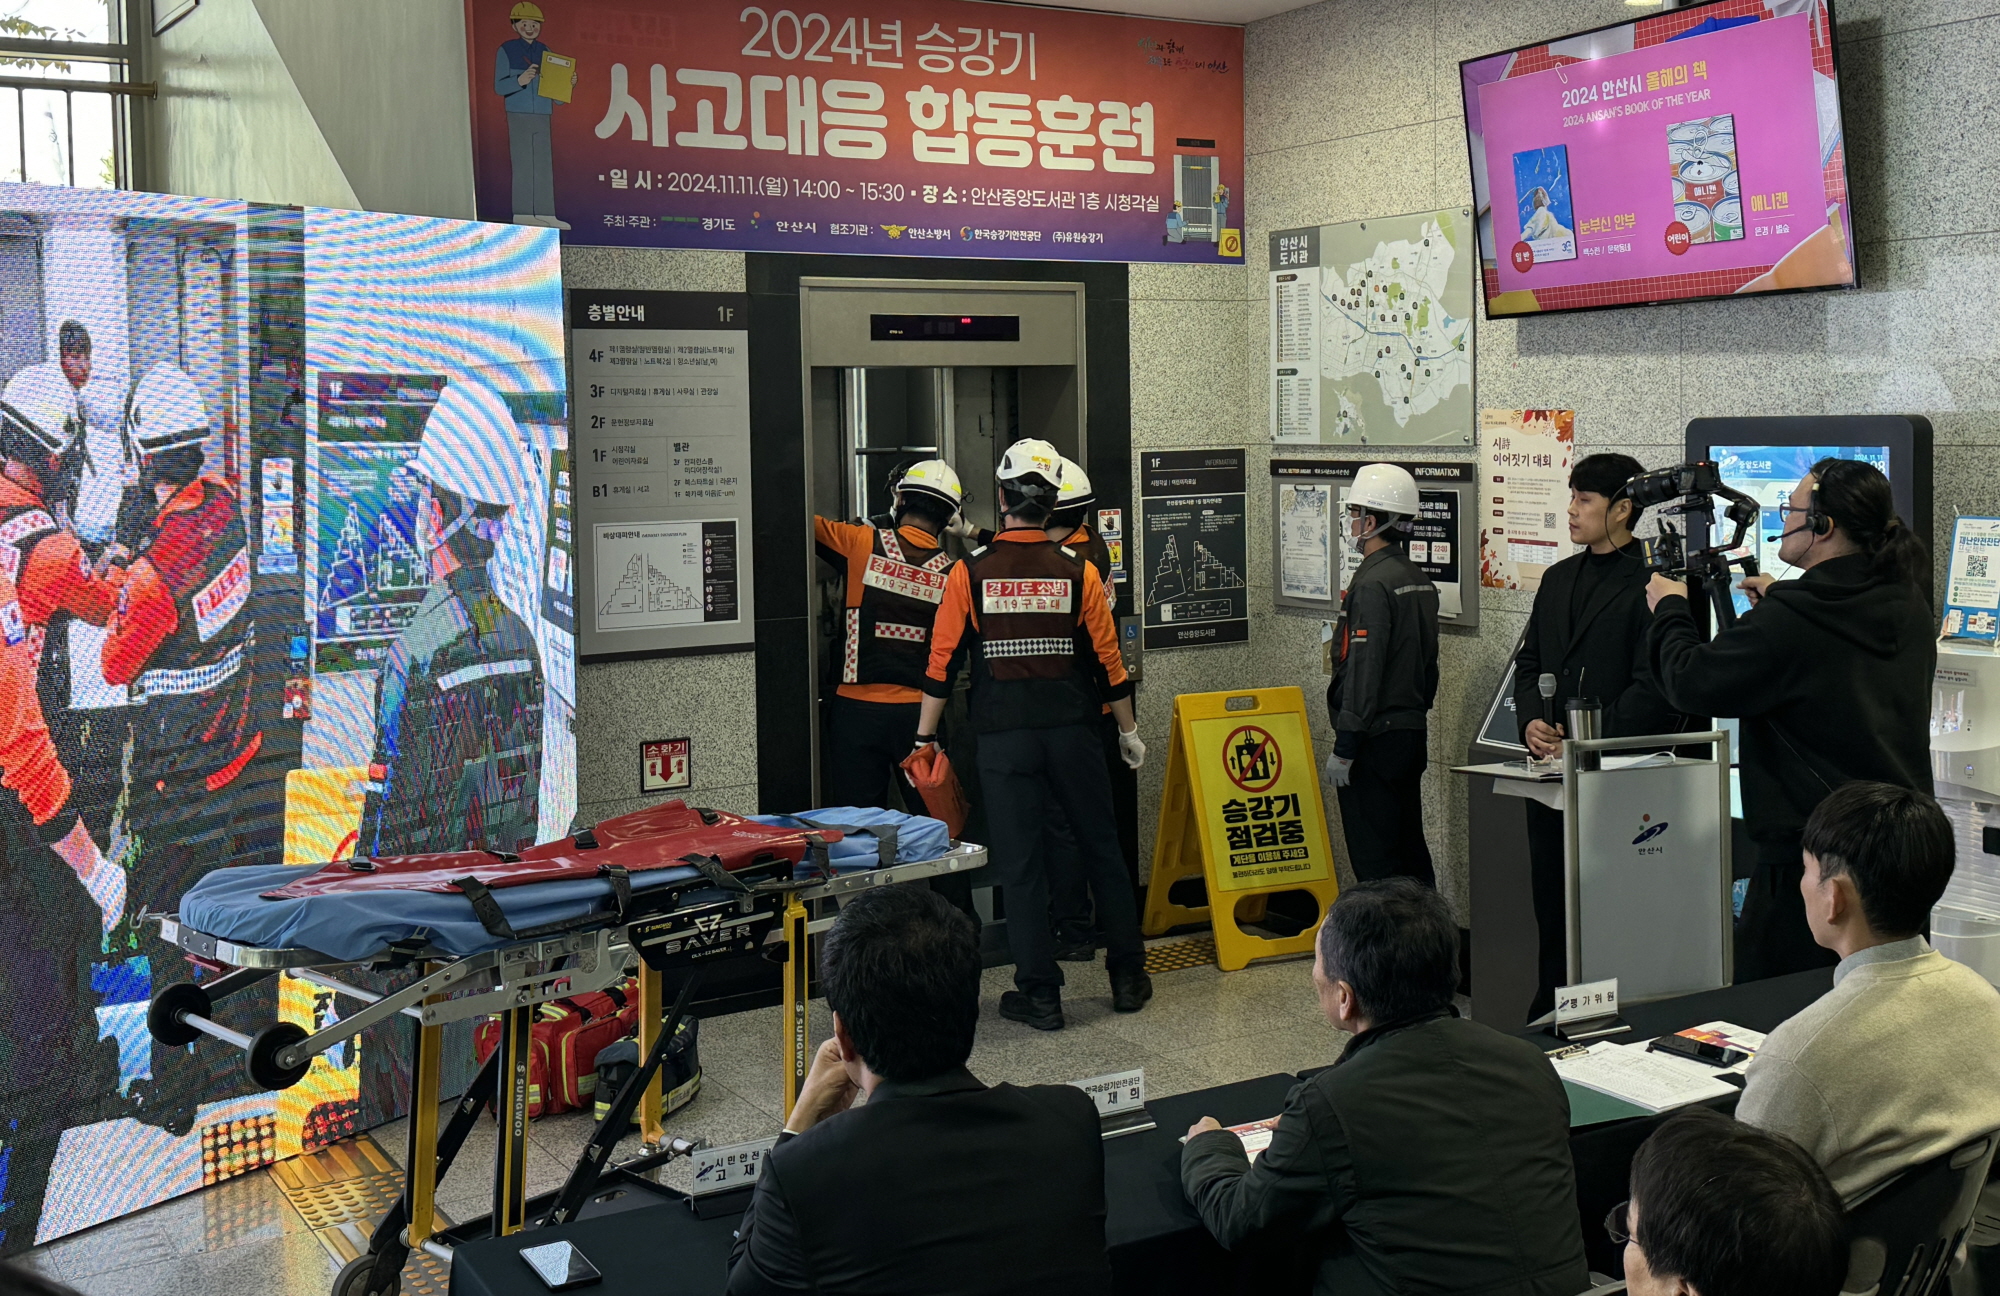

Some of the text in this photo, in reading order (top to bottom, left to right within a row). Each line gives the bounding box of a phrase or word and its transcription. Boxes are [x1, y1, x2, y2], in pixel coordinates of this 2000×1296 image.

[740, 6, 904, 69] 2024년
[916, 22, 1037, 80] 승강기
[1561, 60, 1707, 108] 2024 안산시 올해의 책
[1563, 88, 1711, 127] 2024 ANSAN'S BOOK OF THE YEAR
[595, 62, 1156, 173] 사고대응 합동훈련
[667, 172, 788, 197] 2024.11.11.(월)
[793, 178, 840, 199] 14:00
[860, 182, 904, 202] 15:30
[1693, 184, 1717, 197] 애니캔
[971, 187, 1075, 210] 안산중앙도서관
[1079, 191, 1100, 210] 1층
[1104, 193, 1160, 213] 시청각실
[1751, 191, 1788, 212] 애니캔
[701, 217, 736, 231] 경기도
[776, 220, 817, 234] 안산시
[908, 227, 951, 240] 안산소방서
[974, 229, 1042, 242] 한국승강기안전공단
[1052, 231, 1104, 244] (주)유원승강기
[1580, 213, 1636, 235] 눈부신 안부
[1755, 226, 1768, 237] 은경
[1775, 224, 1790, 234] 별숲
[1280, 235, 1308, 251] 안산시
[1667, 232, 1689, 245] 어린이
[1280, 250, 1308, 265] 도서관
[587, 304, 645, 322] 층별안내
[717, 306, 734, 323] 1F
[588, 348, 604, 363] 4F
[590, 384, 605, 398] 3F
[591, 415, 605, 429] 2F
[673, 442, 690, 453] 별관
[592, 448, 607, 463] 1F
[1150, 457, 1161, 468] 1F
[1493, 453, 1552, 468] 이어짓기 대회
[1036, 462, 1051, 472] 소방
[1414, 467, 1460, 477] INFORMATION
[1739, 460, 1772, 470] 중앙도서관
[592, 483, 608, 497] B1
[603, 530, 641, 539] 비상대피안내
[873, 558, 942, 588] 경기도소방
[874, 575, 934, 600] 119구급대
[989, 581, 1066, 596] 경기도소방
[995, 598, 1060, 610] 119구급대
[1178, 629, 1216, 639] 안산중앙도서관
[646, 742, 685, 755] 소화기
[1222, 793, 1301, 823] 승강기
[1226, 819, 1305, 850] 점검중
[1233, 848, 1306, 865] 계단을 이용해 주세요
[1638, 846, 1663, 855] 안산시
[1278, 863, 1311, 873] 부탁드립니다
[694, 913, 723, 932] EZ
[665, 924, 752, 955] SAVER
[796, 1018, 804, 1077] SUNGWOO
[1085, 1076, 1140, 1094] 한국승강기안전공단
[514, 1078, 524, 1137] SUNGWOO
